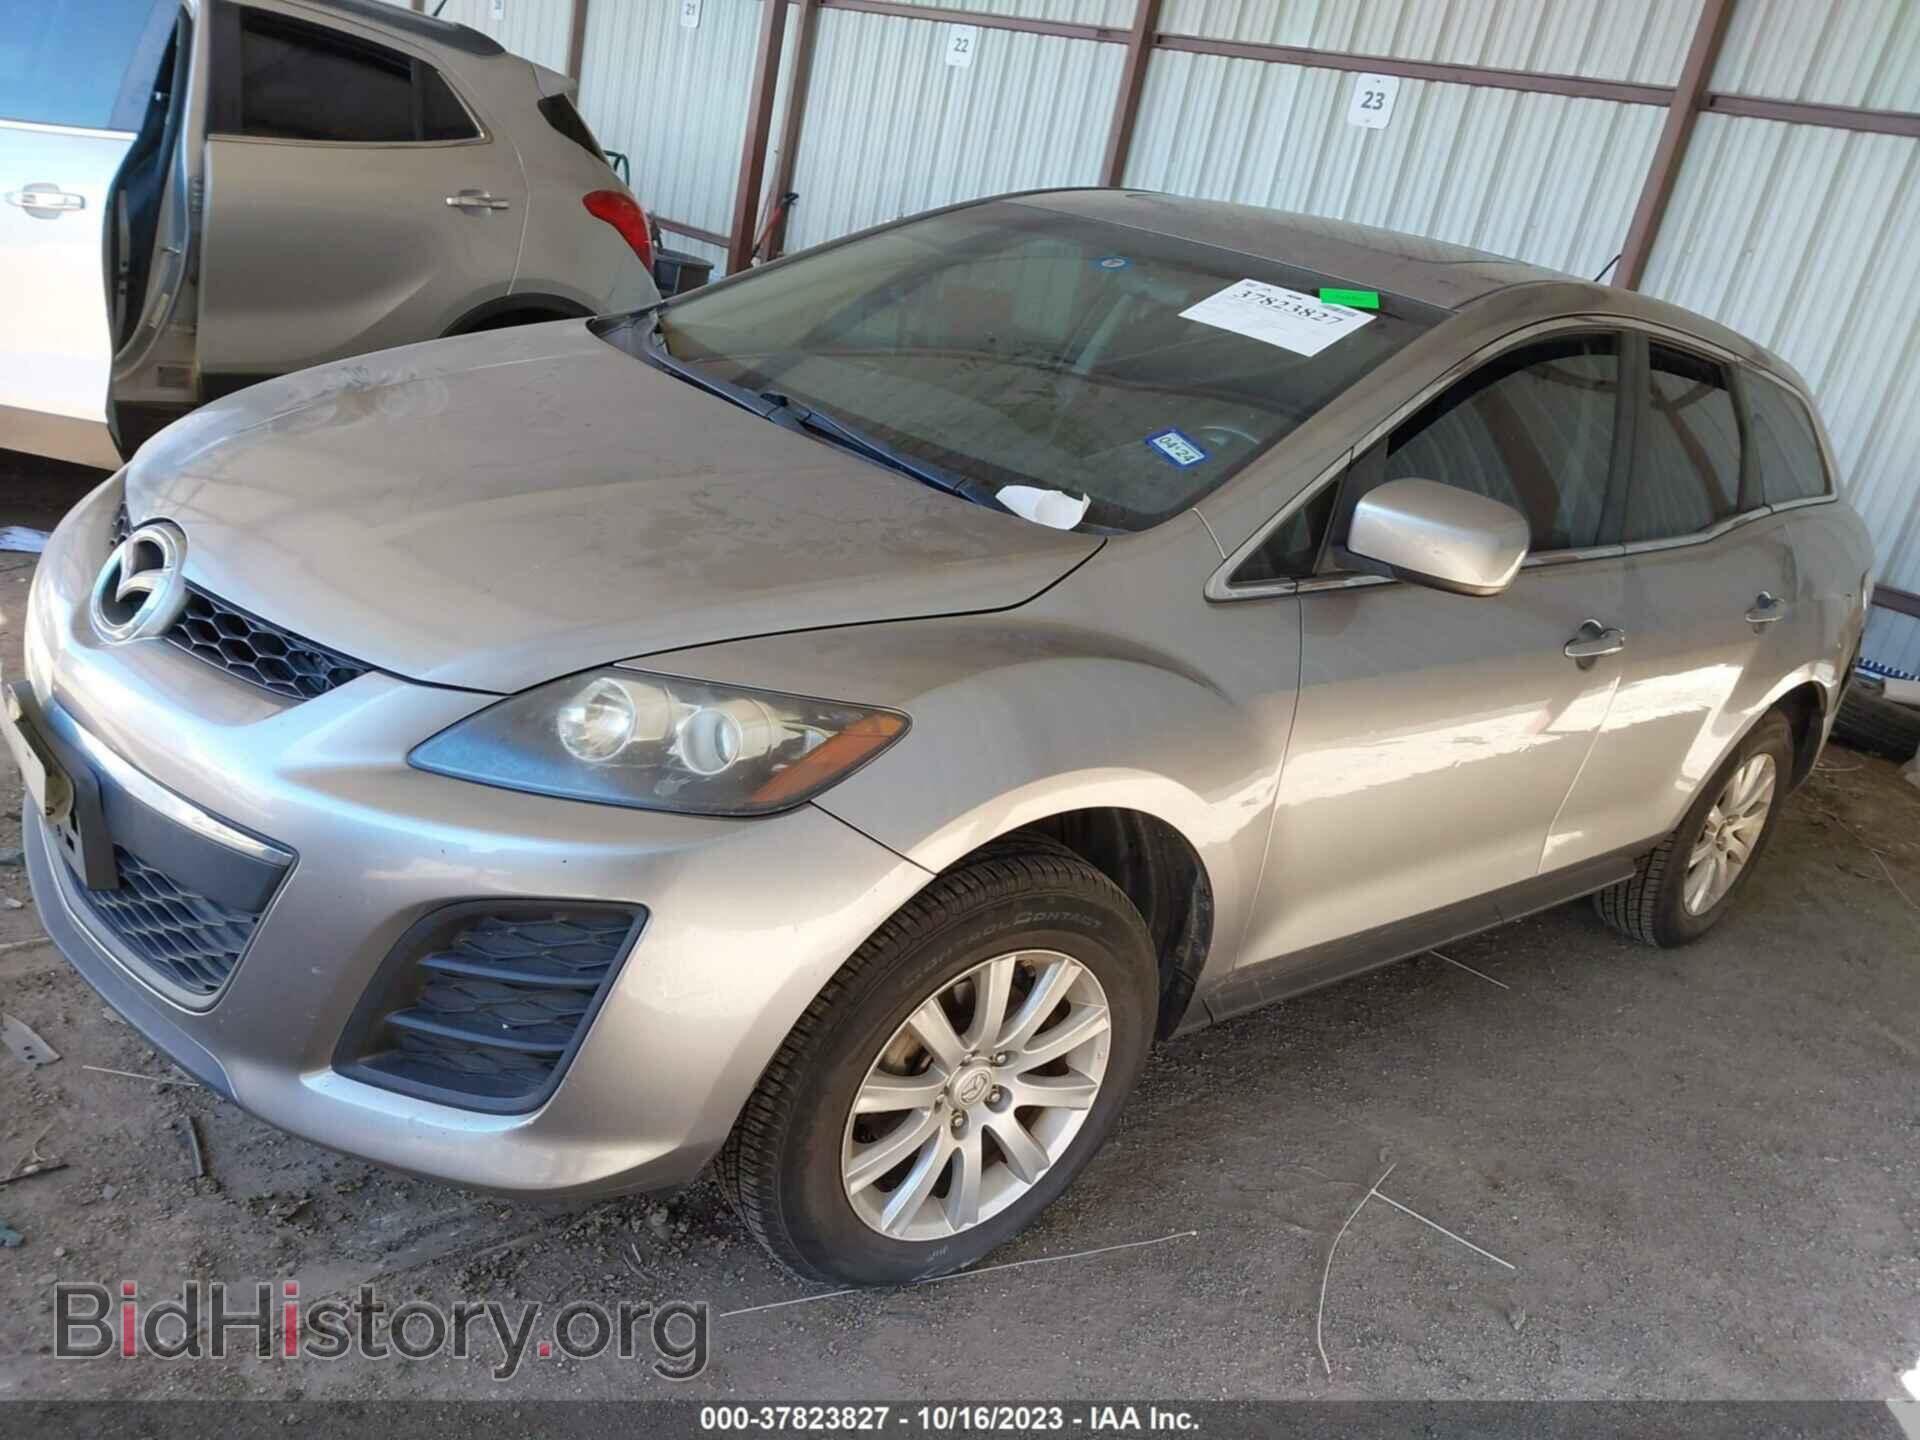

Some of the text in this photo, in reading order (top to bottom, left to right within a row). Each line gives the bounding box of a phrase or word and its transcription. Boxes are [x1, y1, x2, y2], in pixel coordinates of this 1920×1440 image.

[954, 37, 969, 53] 22
[1361, 90, 1385, 110] 23
[1233, 289, 1344, 325] 37823827
